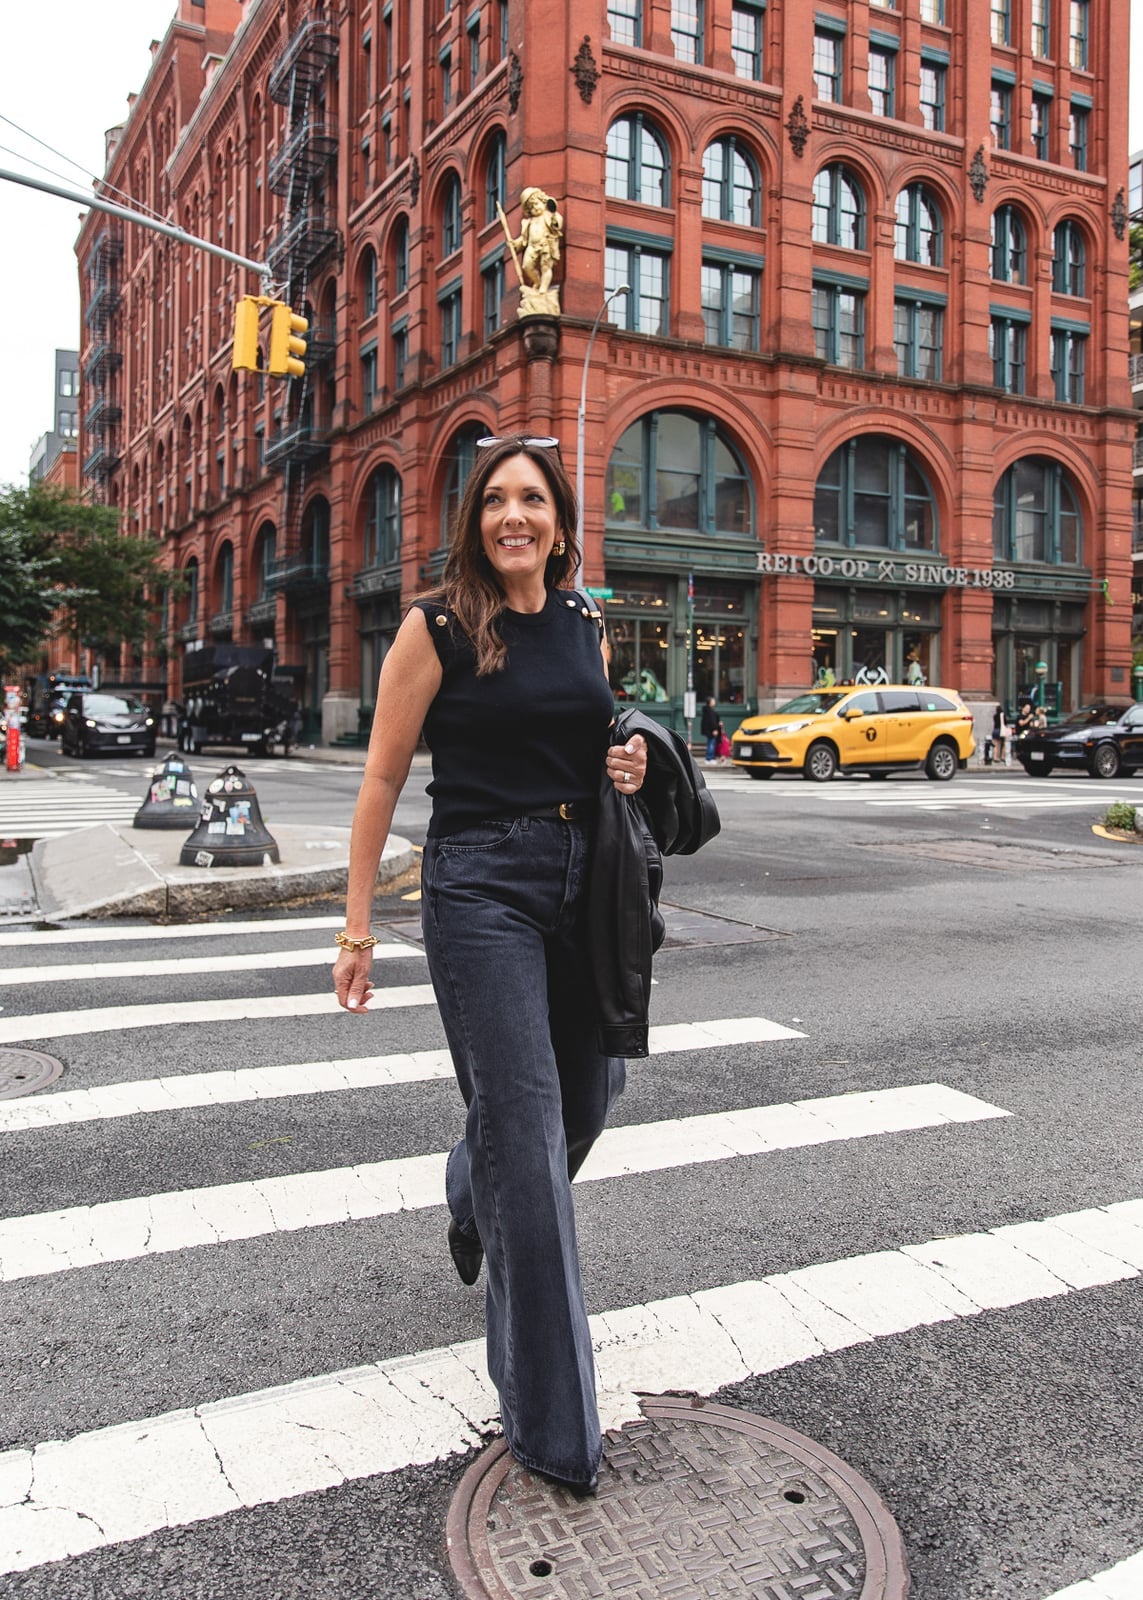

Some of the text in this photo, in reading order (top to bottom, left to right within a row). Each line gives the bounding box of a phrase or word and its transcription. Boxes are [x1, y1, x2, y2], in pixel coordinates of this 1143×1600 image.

[756, 552, 1015, 589] REI CO-OP SINCE 1938
